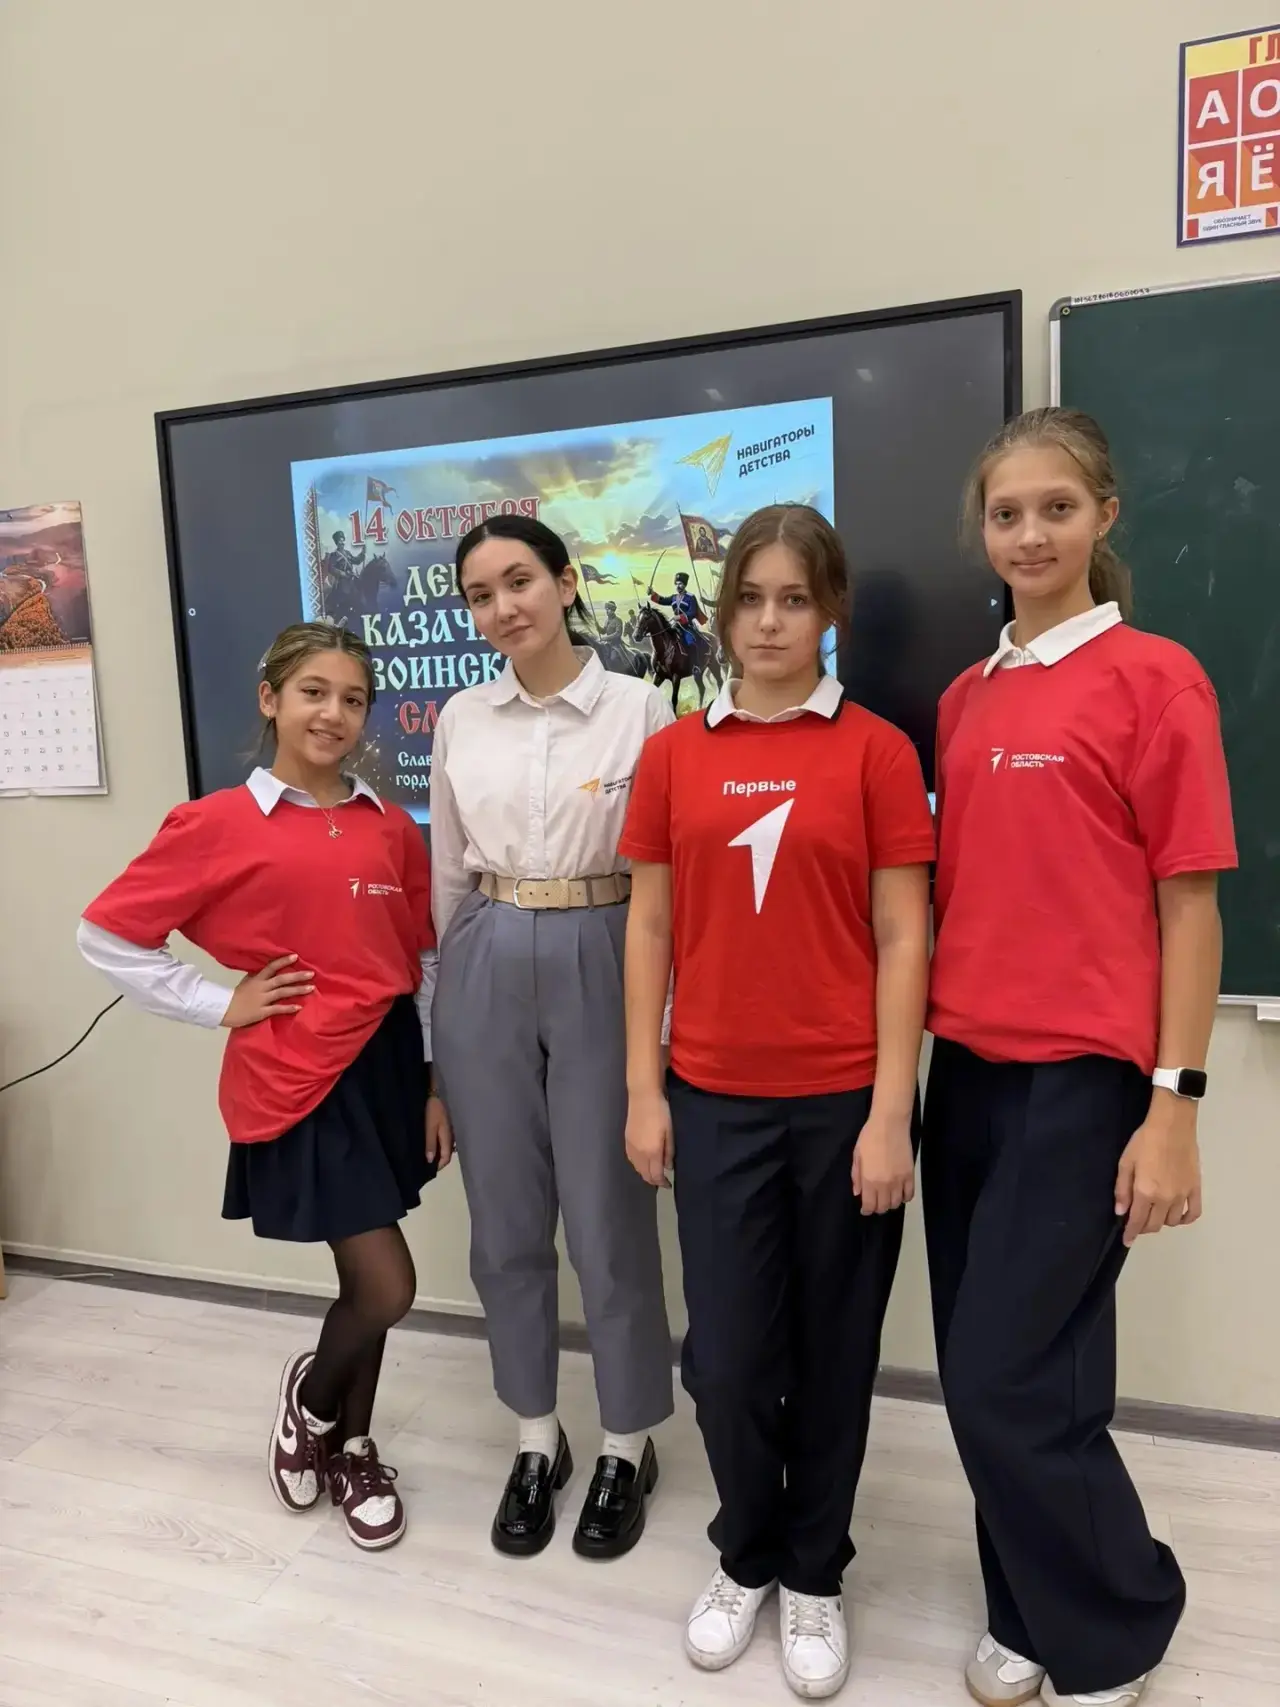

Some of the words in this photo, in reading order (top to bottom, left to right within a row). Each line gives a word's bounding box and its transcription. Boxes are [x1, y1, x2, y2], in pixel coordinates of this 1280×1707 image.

[1249, 33, 1280, 65] ГЛ
[1196, 89, 1230, 128] А
[1250, 79, 1280, 118] О
[1197, 160, 1225, 199] Я
[1252, 143, 1275, 191] Ё
[737, 424, 815, 460] НАВИГАТОРЫ
[738, 449, 791, 478] ДЕТСТВА
[349, 506, 388, 546] 14
[403, 563, 461, 606] ДЕ
[361, 608, 487, 648] КАЗАЧ
[372, 651, 512, 691] ВОИНСК
[397, 751, 433, 767] Слав
[1010, 761, 1045, 769] ОБЛАСТЬ
[1011, 753, 1065, 763] РОСТОВСКАЯ
[395, 774, 431, 790] горд
[723, 779, 797, 798] Первые
